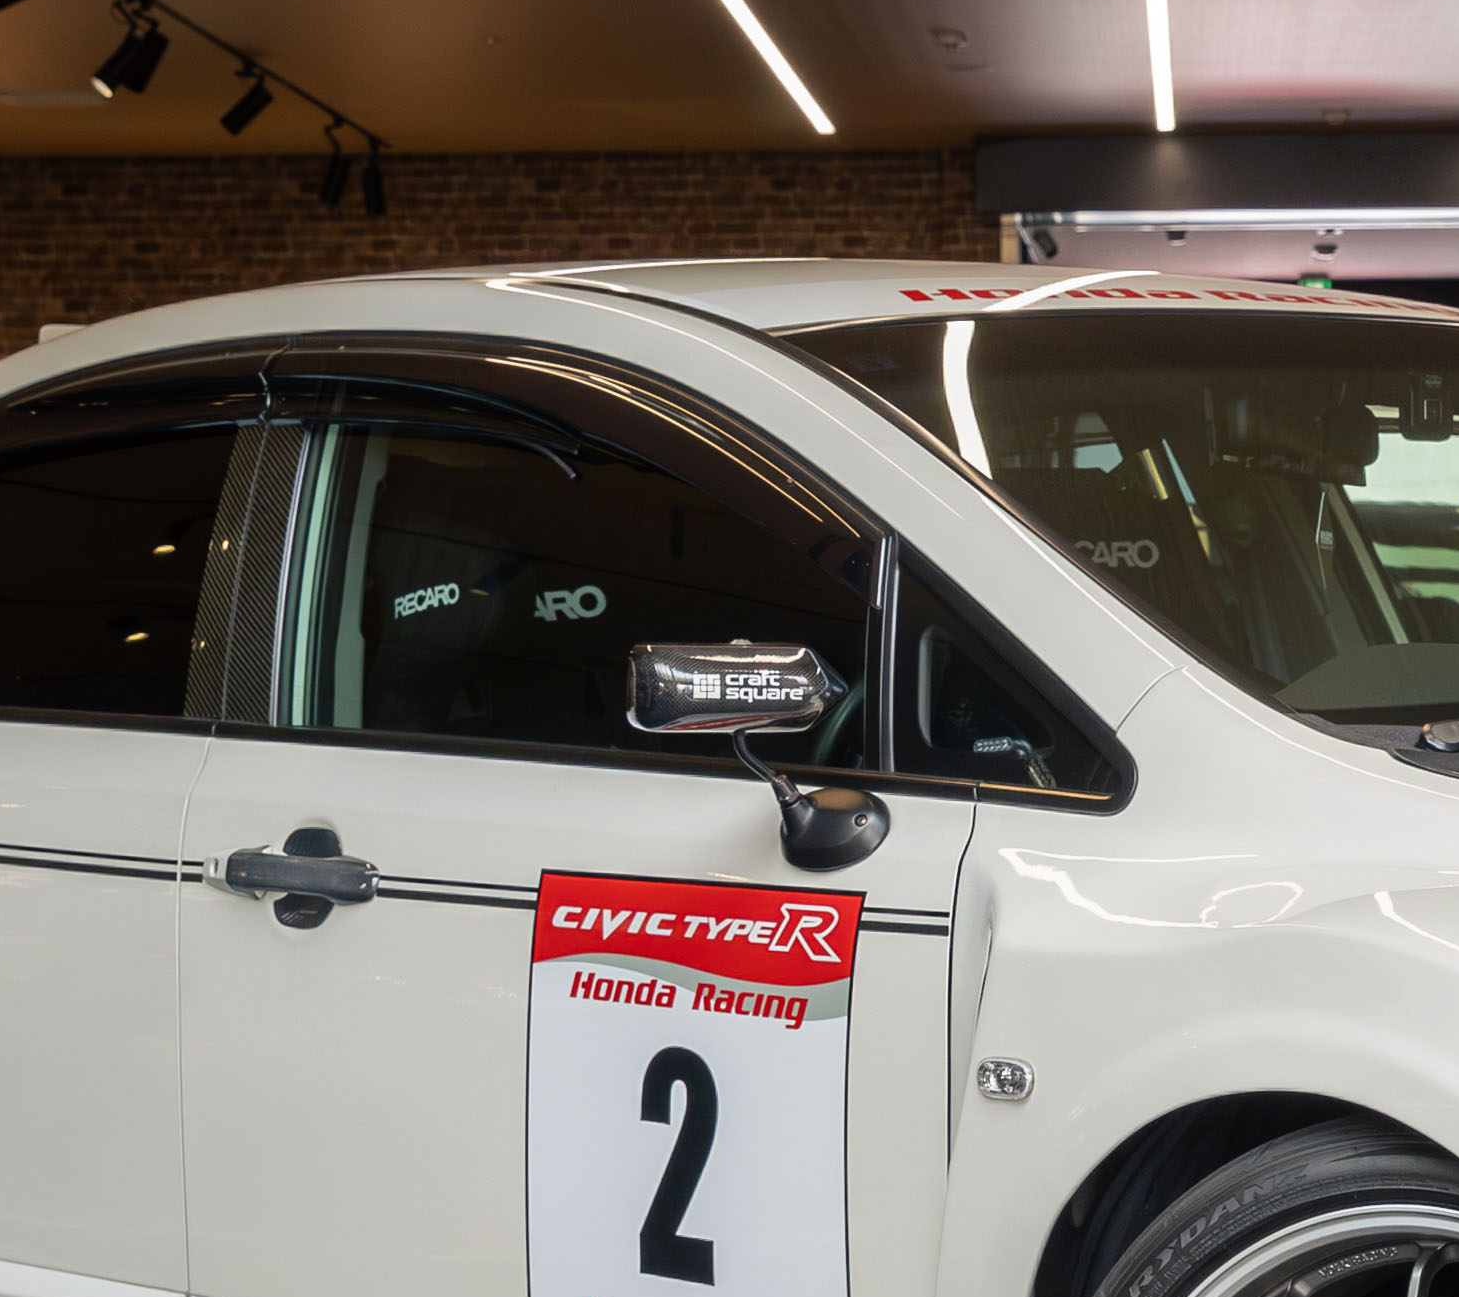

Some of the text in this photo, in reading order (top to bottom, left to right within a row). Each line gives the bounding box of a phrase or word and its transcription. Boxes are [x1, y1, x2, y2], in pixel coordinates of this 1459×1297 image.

[394, 582, 460, 620] RECARO
[725, 670, 781, 686] craft
[725, 687, 805, 703] square
[551, 904, 675, 942] CIVIC
[569, 971, 809, 1030] Honda Racing
[640, 1045, 720, 1287] 2
